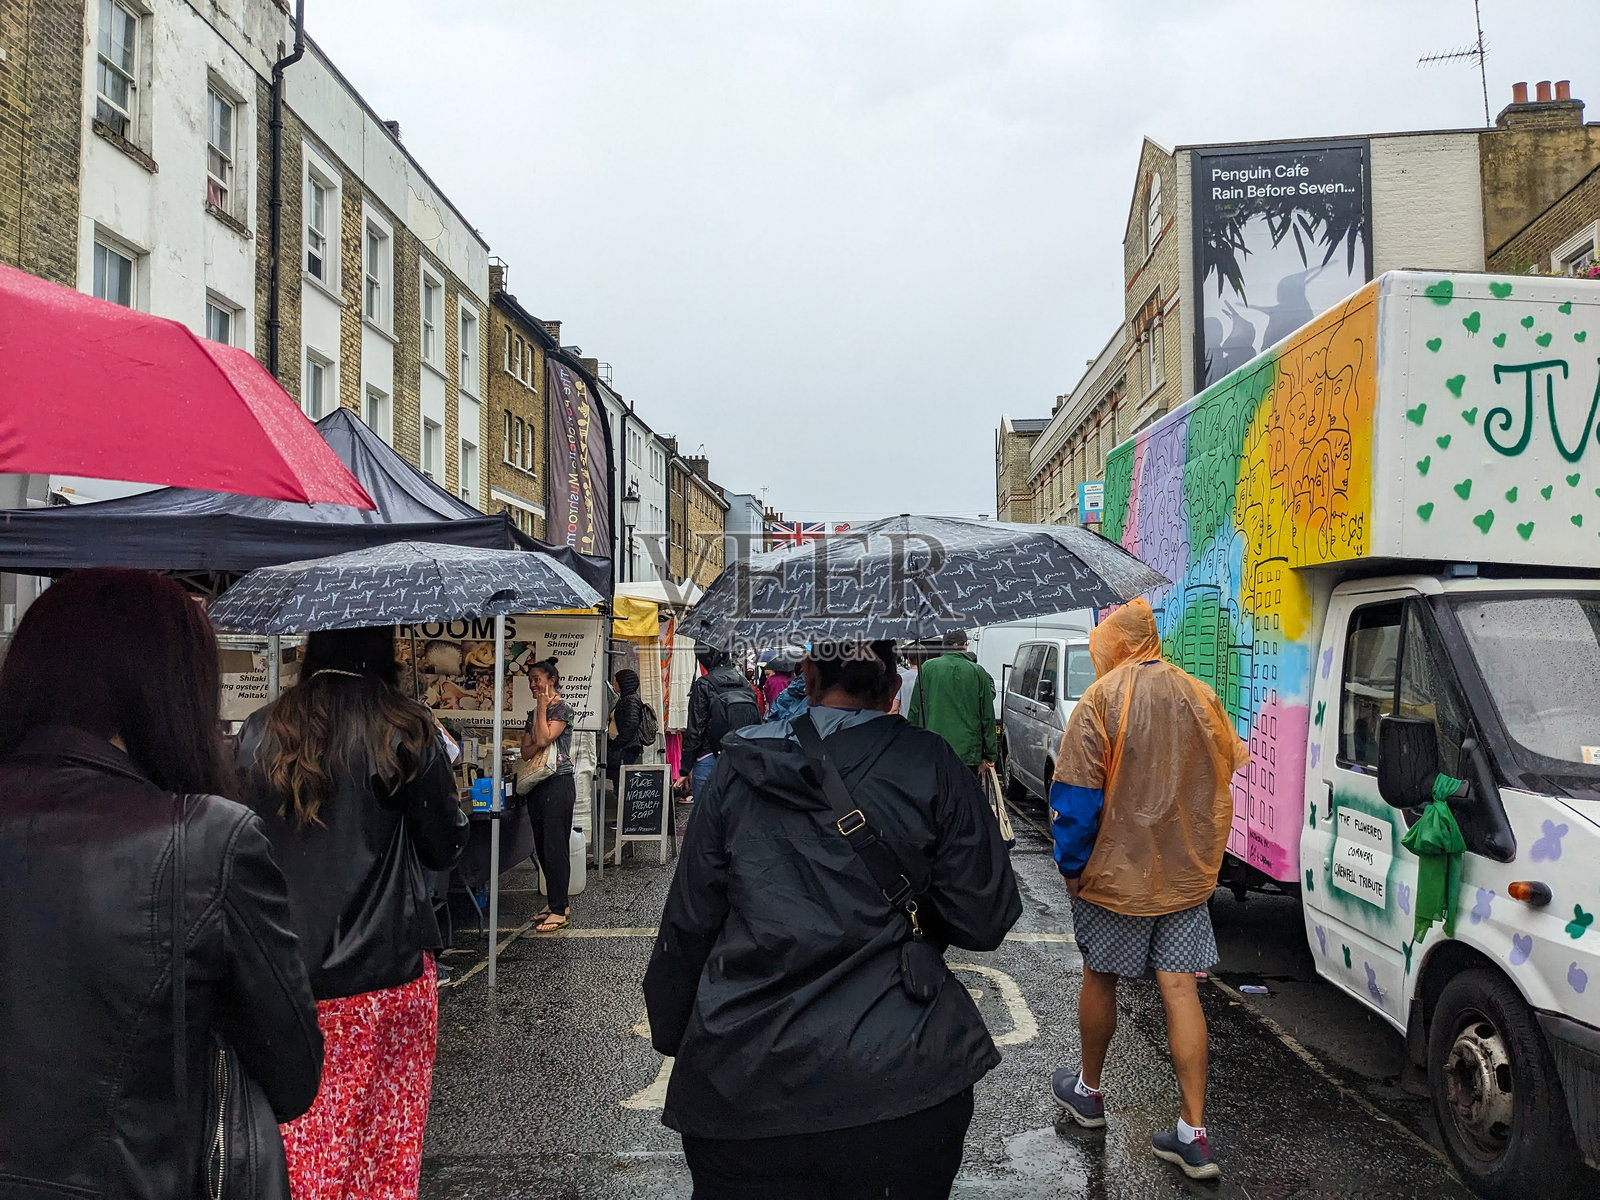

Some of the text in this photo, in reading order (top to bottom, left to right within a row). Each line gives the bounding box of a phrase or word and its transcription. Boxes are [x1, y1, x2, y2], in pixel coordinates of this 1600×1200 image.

[1212, 164, 1309, 182] Penguin Cafe
[1212, 182, 1355, 200] Rain Before Seven...
[1484, 359, 1600, 463] JV
[544, 632, 558, 640] Big
[630, 777, 653, 788] PURE
[626, 790, 660, 800] NATURAL
[632, 800, 660, 811] FRENCH
[631, 810, 654, 821] SOAP
[1338, 813, 1383, 841] THE FLOWERED
[1347, 847, 1374, 866] CORNERS
[1334, 862, 1383, 897] GRENFELL TRIBUTE
